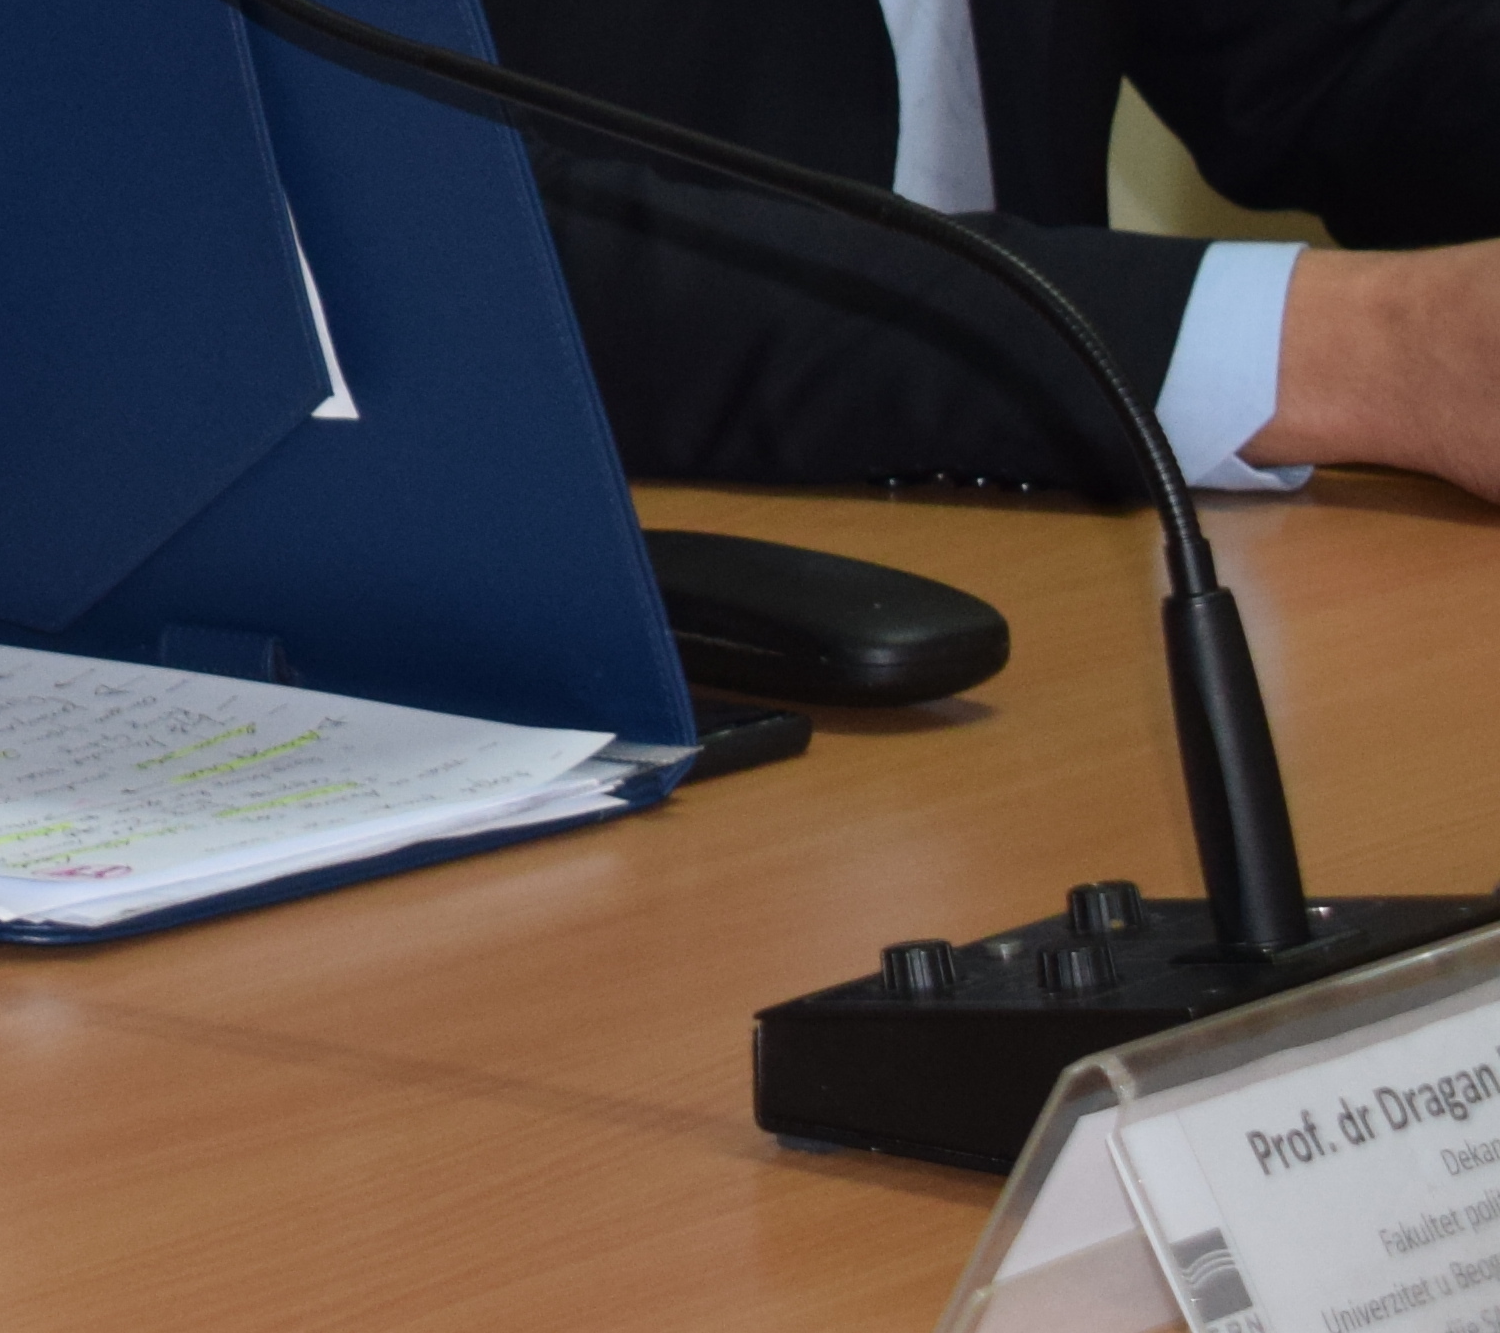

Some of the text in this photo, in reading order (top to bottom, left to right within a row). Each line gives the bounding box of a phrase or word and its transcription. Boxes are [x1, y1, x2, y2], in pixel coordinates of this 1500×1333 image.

[1245, 1063, 1500, 1176] Prof. dr Dragan
[1378, 1189, 1500, 1258] Fakultet poli
[1320, 1276, 1436, 1333] Univerzitet
